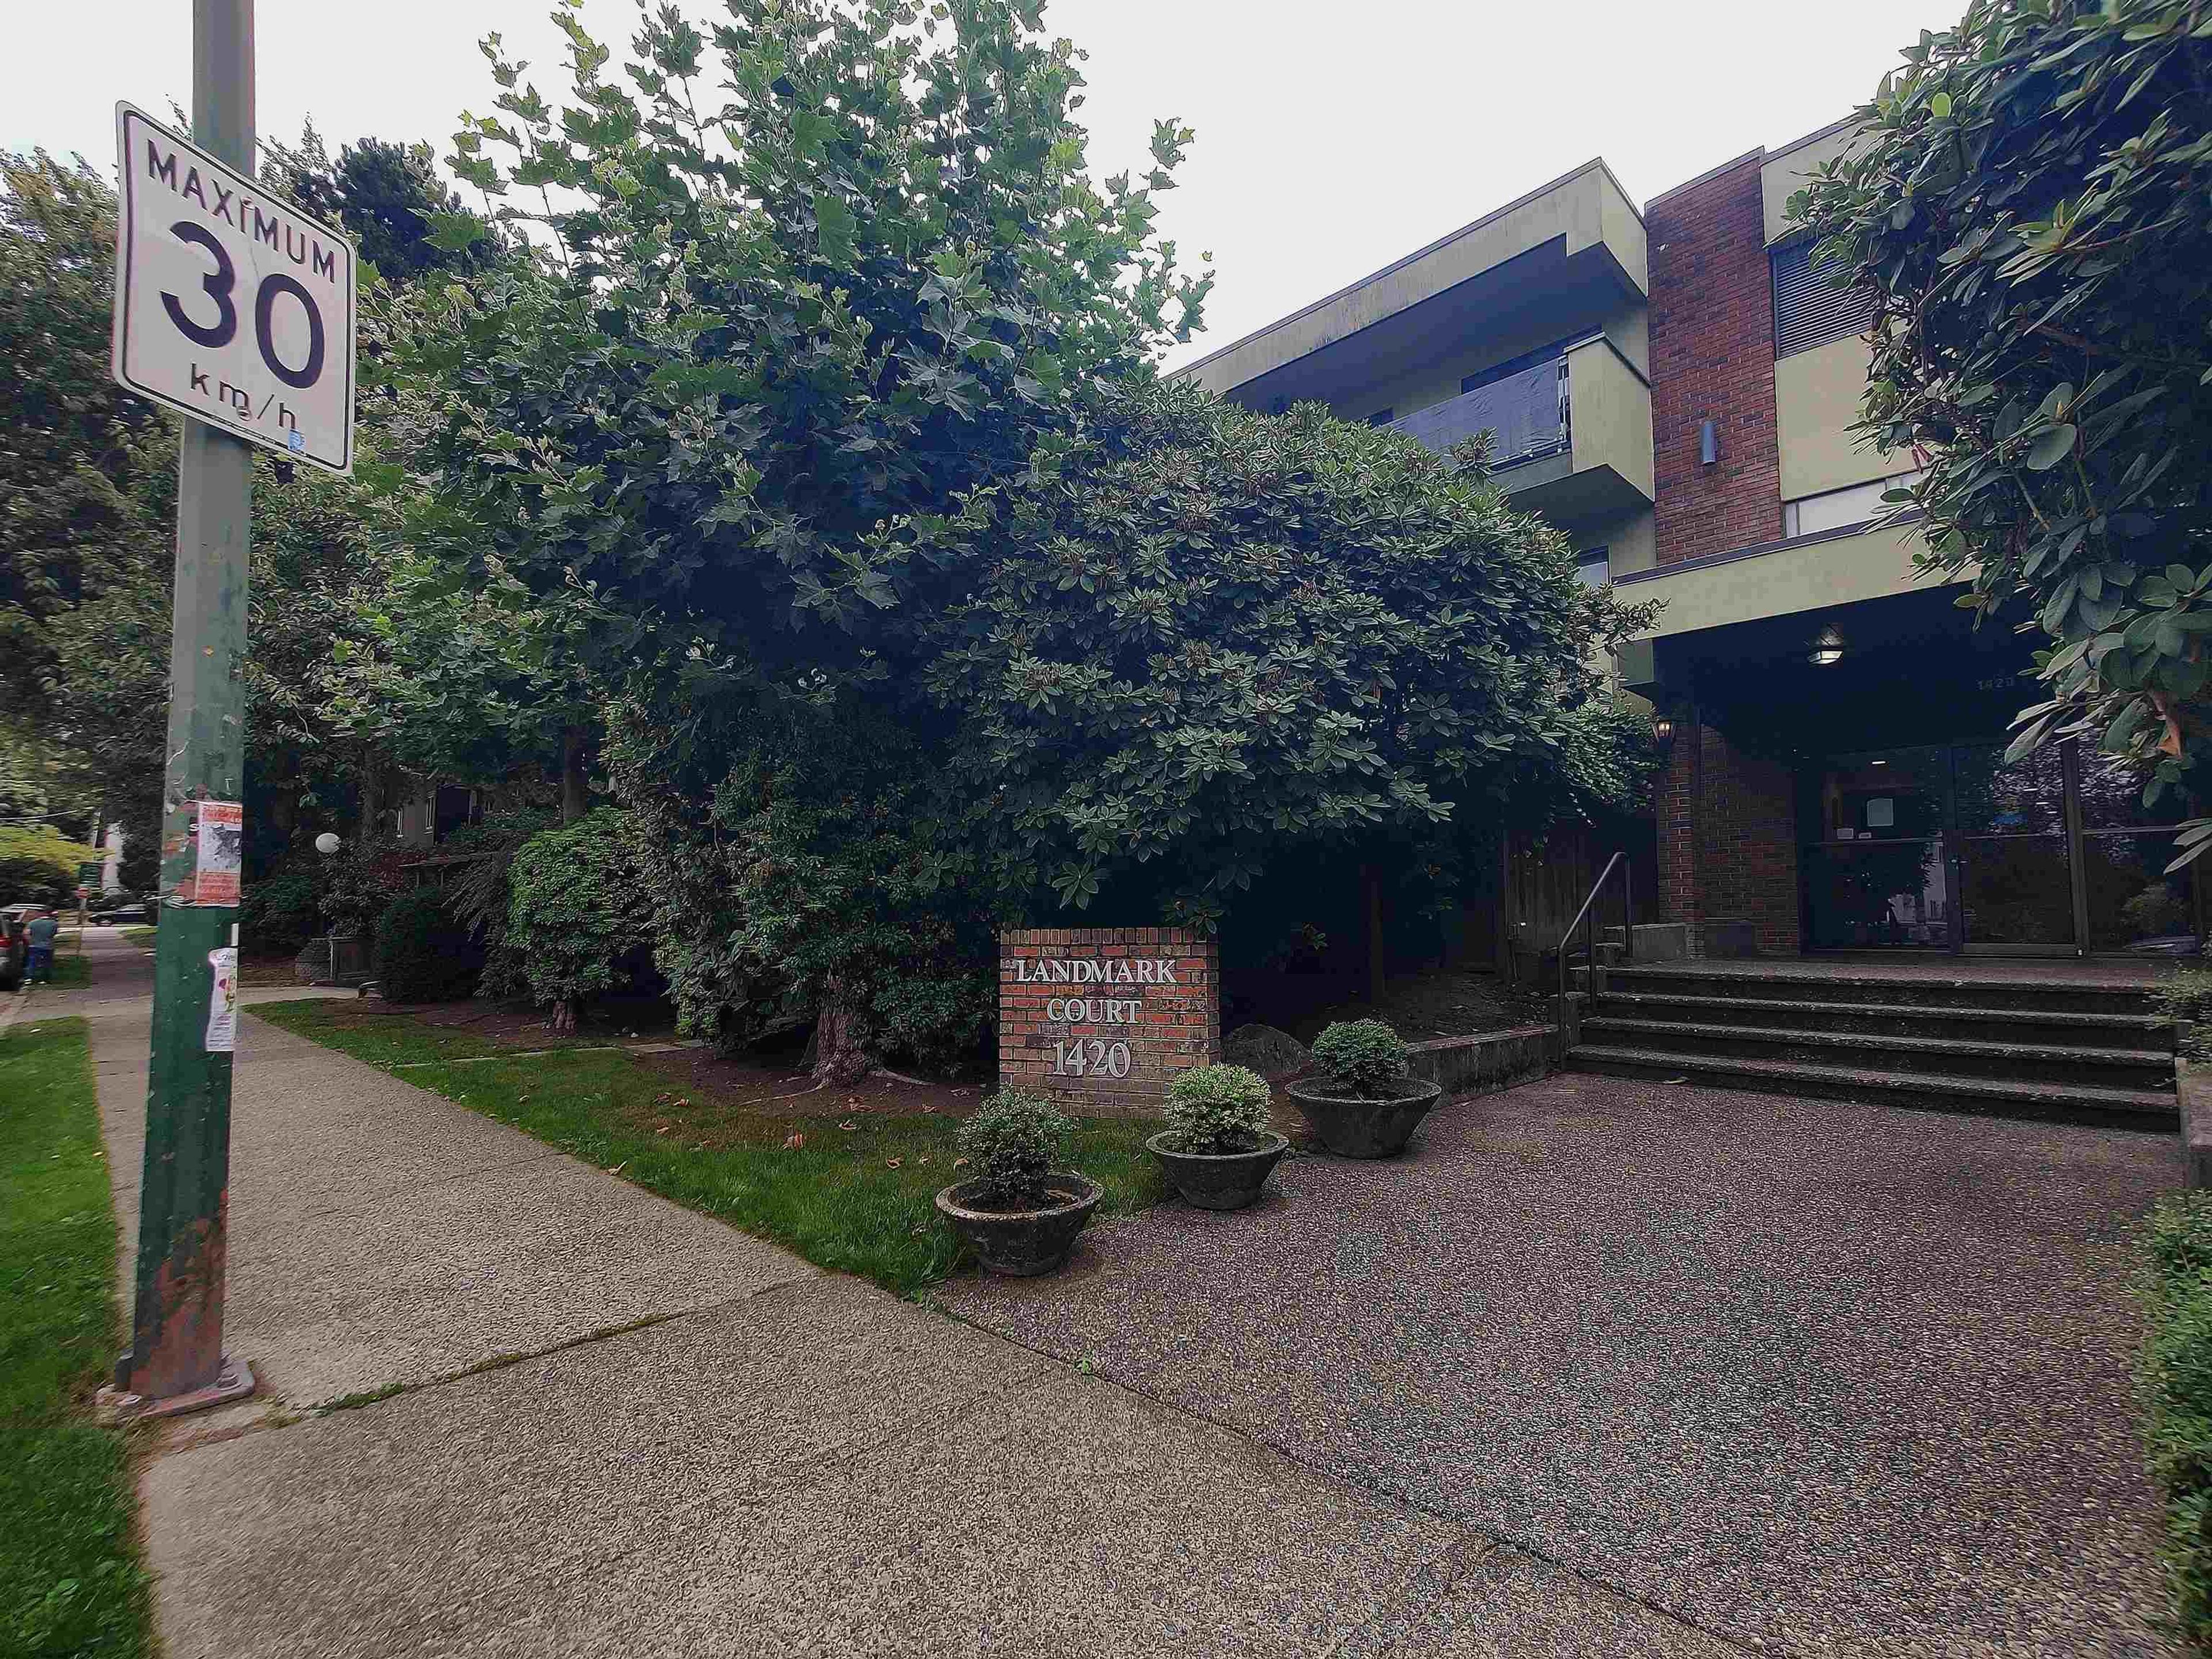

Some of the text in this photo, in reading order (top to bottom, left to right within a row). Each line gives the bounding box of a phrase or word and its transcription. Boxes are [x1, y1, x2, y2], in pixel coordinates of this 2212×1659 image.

[147, 139, 335, 284] MAXIMUM
[160, 221, 325, 389] 30
[190, 363, 296, 429] km/h
[1016, 960, 1177, 983] LANDMARK
[1047, 998, 1142, 1023] COURT
[1054, 1039, 1131, 1078] 1420
